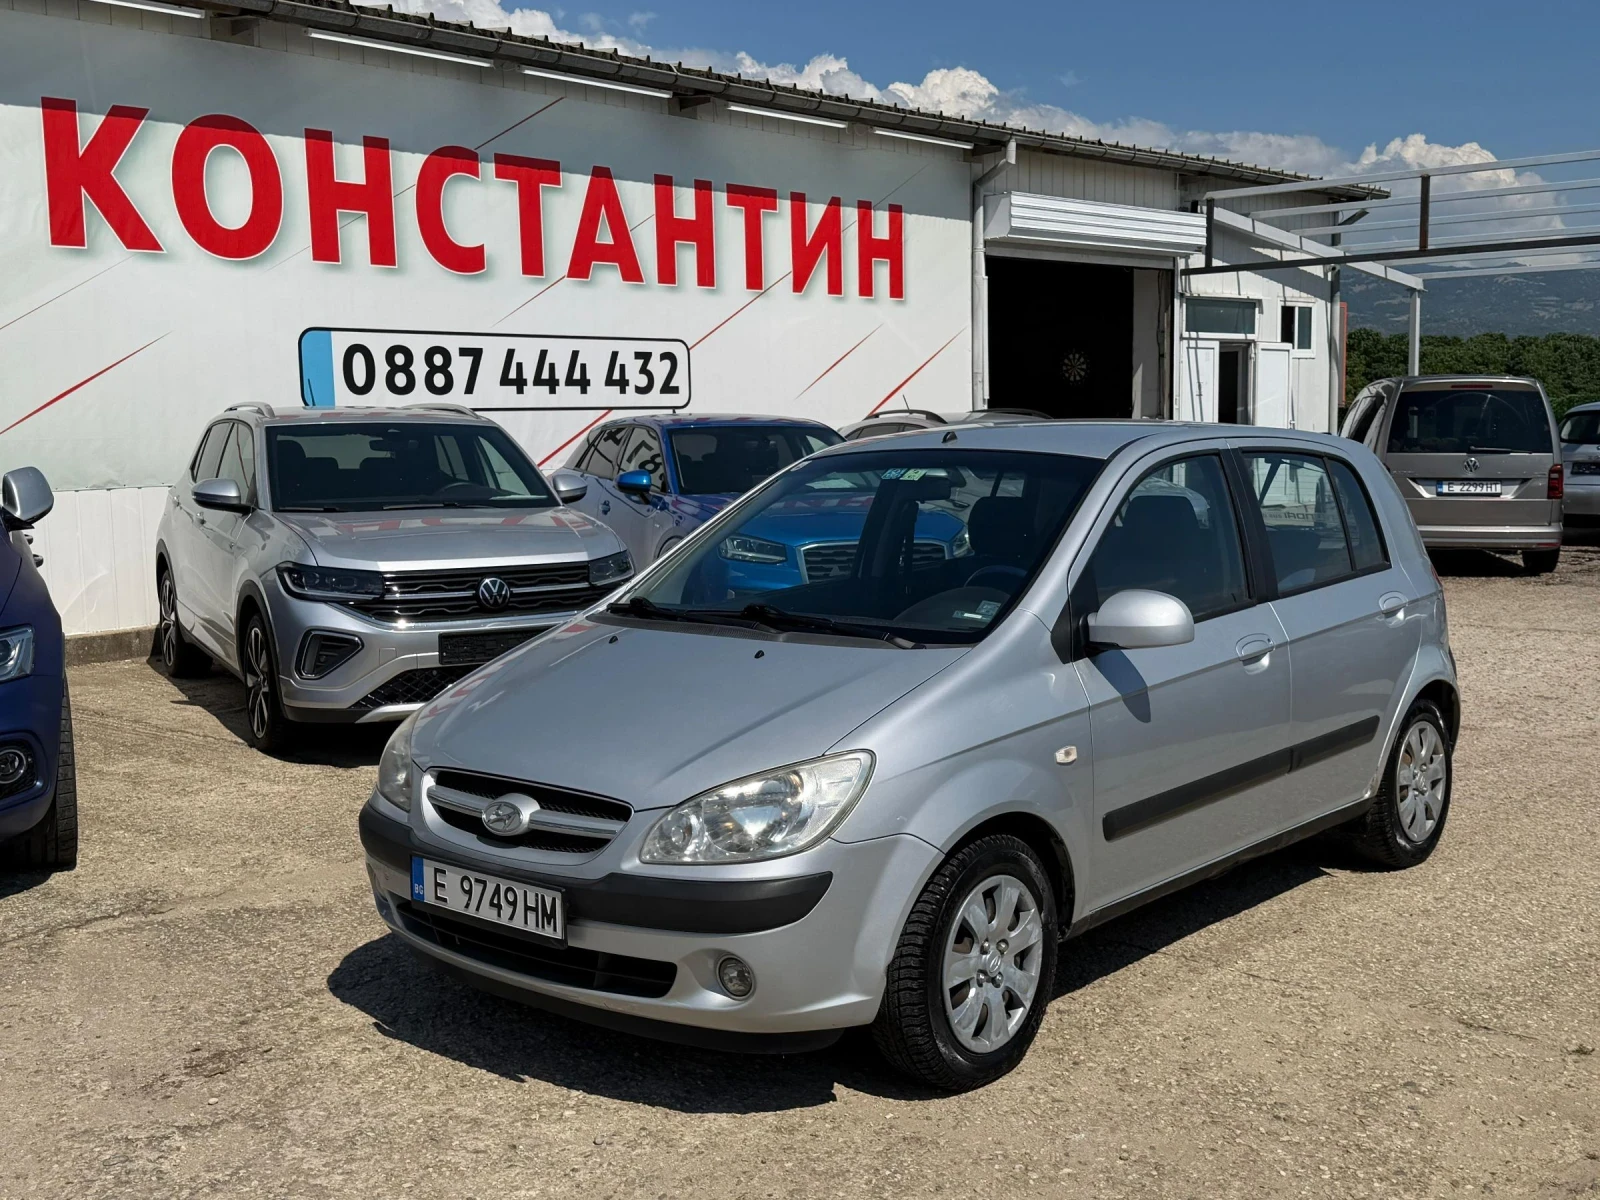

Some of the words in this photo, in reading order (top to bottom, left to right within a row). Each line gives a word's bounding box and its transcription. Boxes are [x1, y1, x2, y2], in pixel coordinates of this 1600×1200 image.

[41, 96, 904, 300] КОНСТАНТИН
[342, 343, 484, 396] 0887
[499, 348, 591, 395] 444
[604, 350, 680, 395] 432
[414, 883, 424, 895] BG
[433, 866, 448, 904] E
